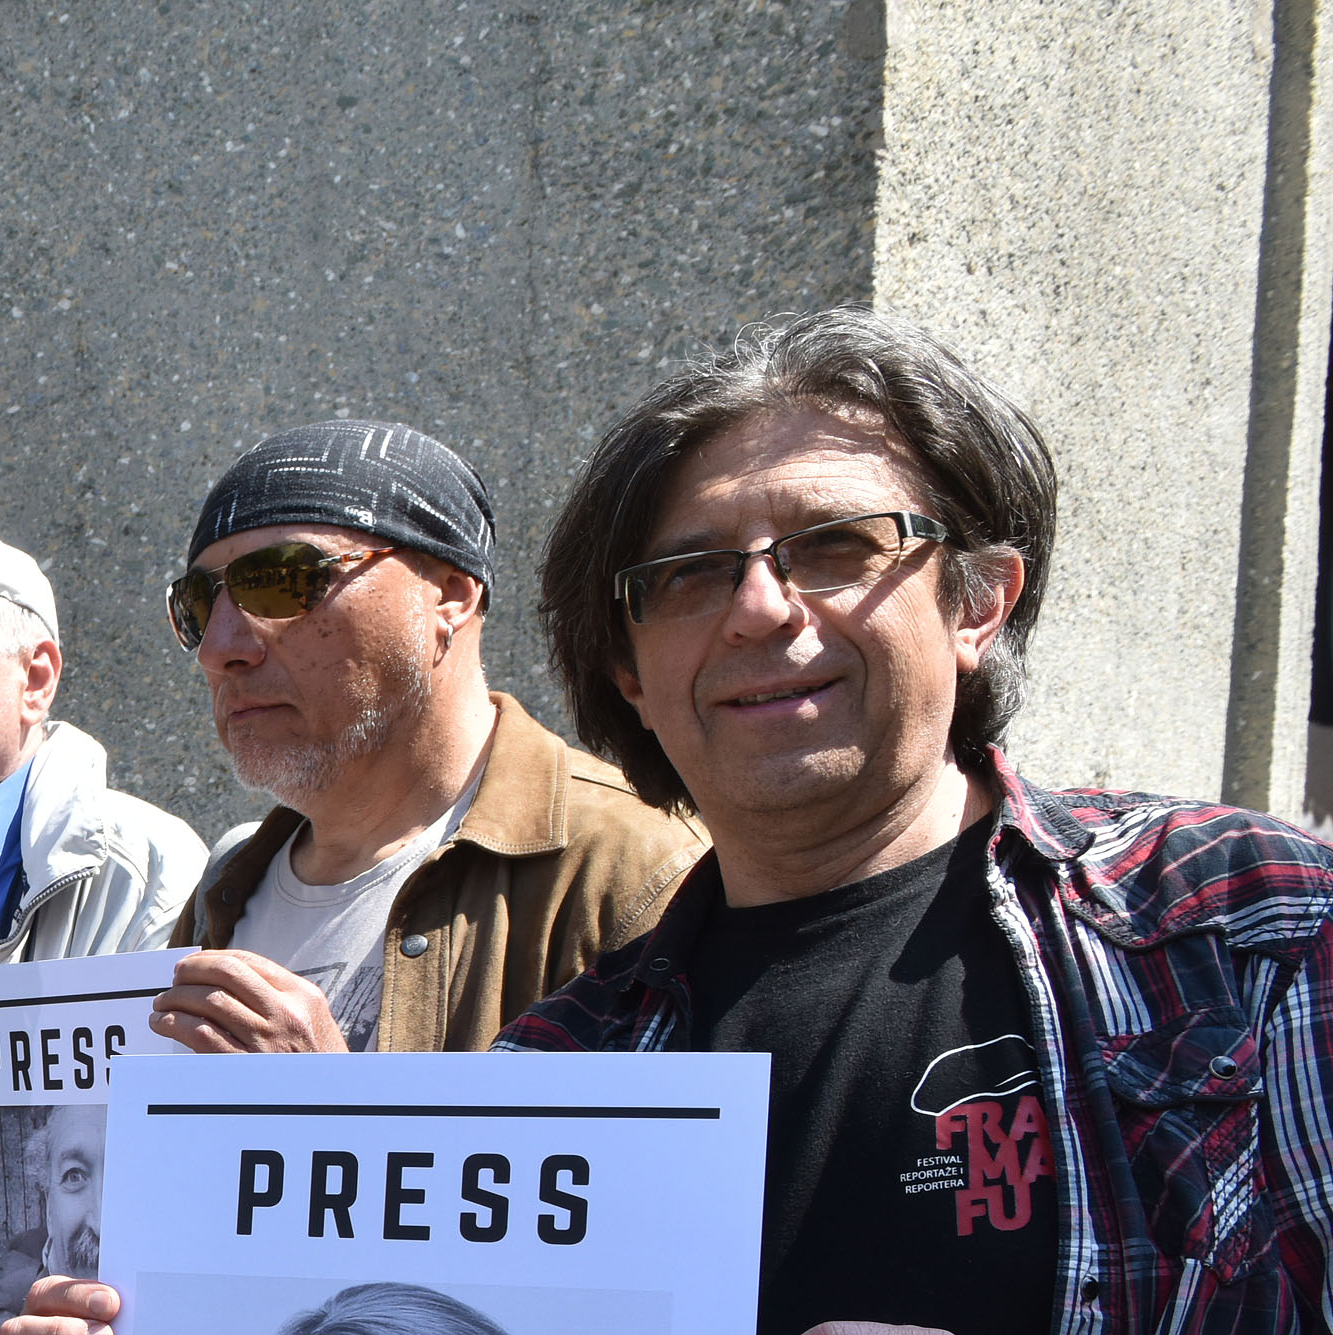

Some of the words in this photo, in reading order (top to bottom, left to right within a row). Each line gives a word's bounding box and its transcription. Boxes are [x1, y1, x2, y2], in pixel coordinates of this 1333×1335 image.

[936, 1096, 1048, 1150] FRA
[900, 1167, 957, 1182] REPORTAŽE
[917, 1155, 963, 1167] FESTIVAL
[236, 1149, 590, 1246] PRESS
[905, 1178, 964, 1194] REPORTERA
[956, 1181, 1033, 1236] FU
